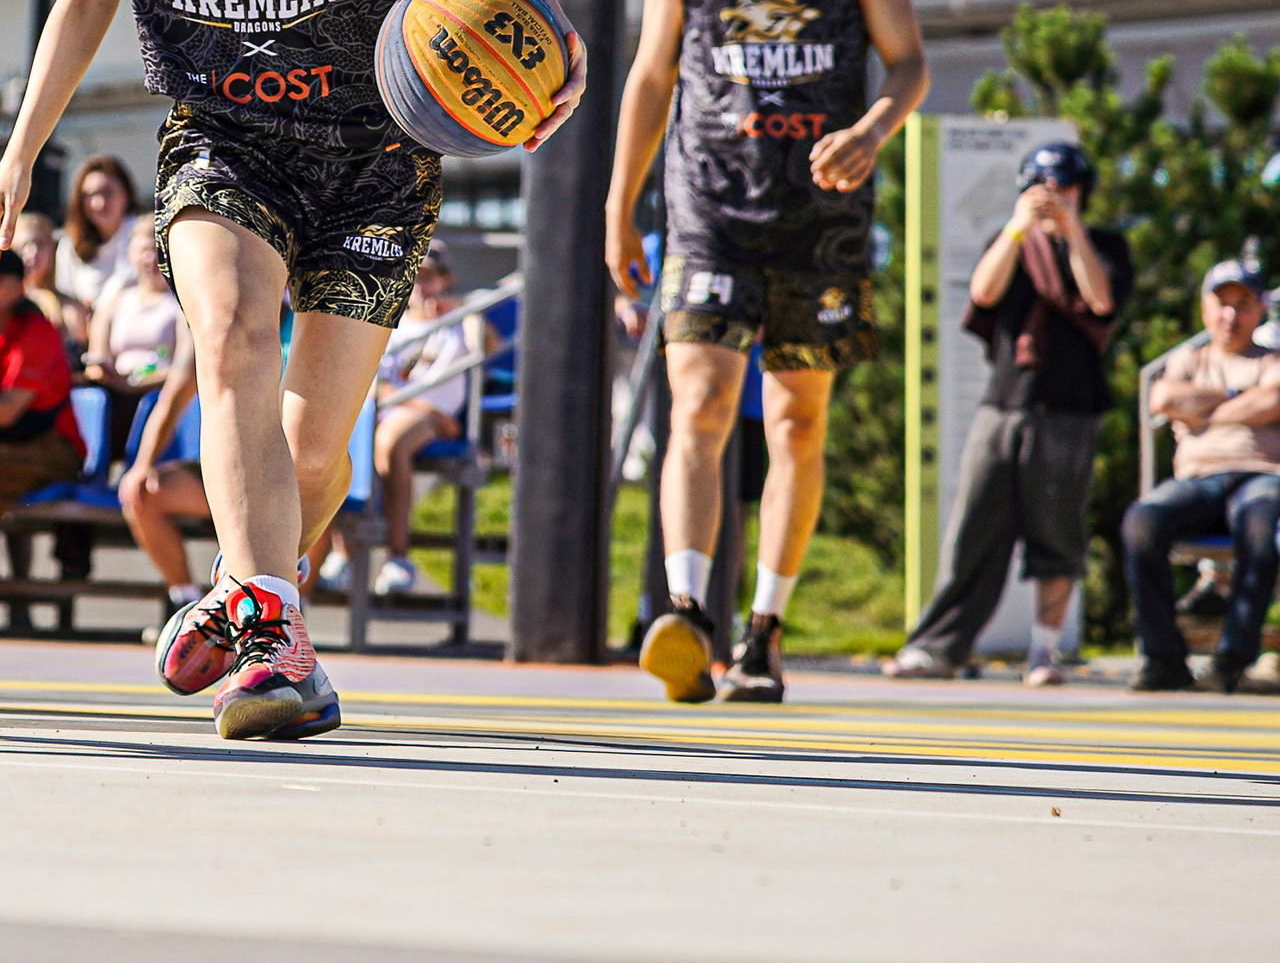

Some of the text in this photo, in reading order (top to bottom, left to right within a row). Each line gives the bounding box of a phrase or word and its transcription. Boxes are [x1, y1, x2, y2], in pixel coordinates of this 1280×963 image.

[234, 21, 281, 33] DRAGONS
[711, 43, 835, 76] KREMLIN
[186, 72, 207, 84] THE
[429, 27, 525, 138] Wilson
[343, 236, 404, 257] KREMLIN
